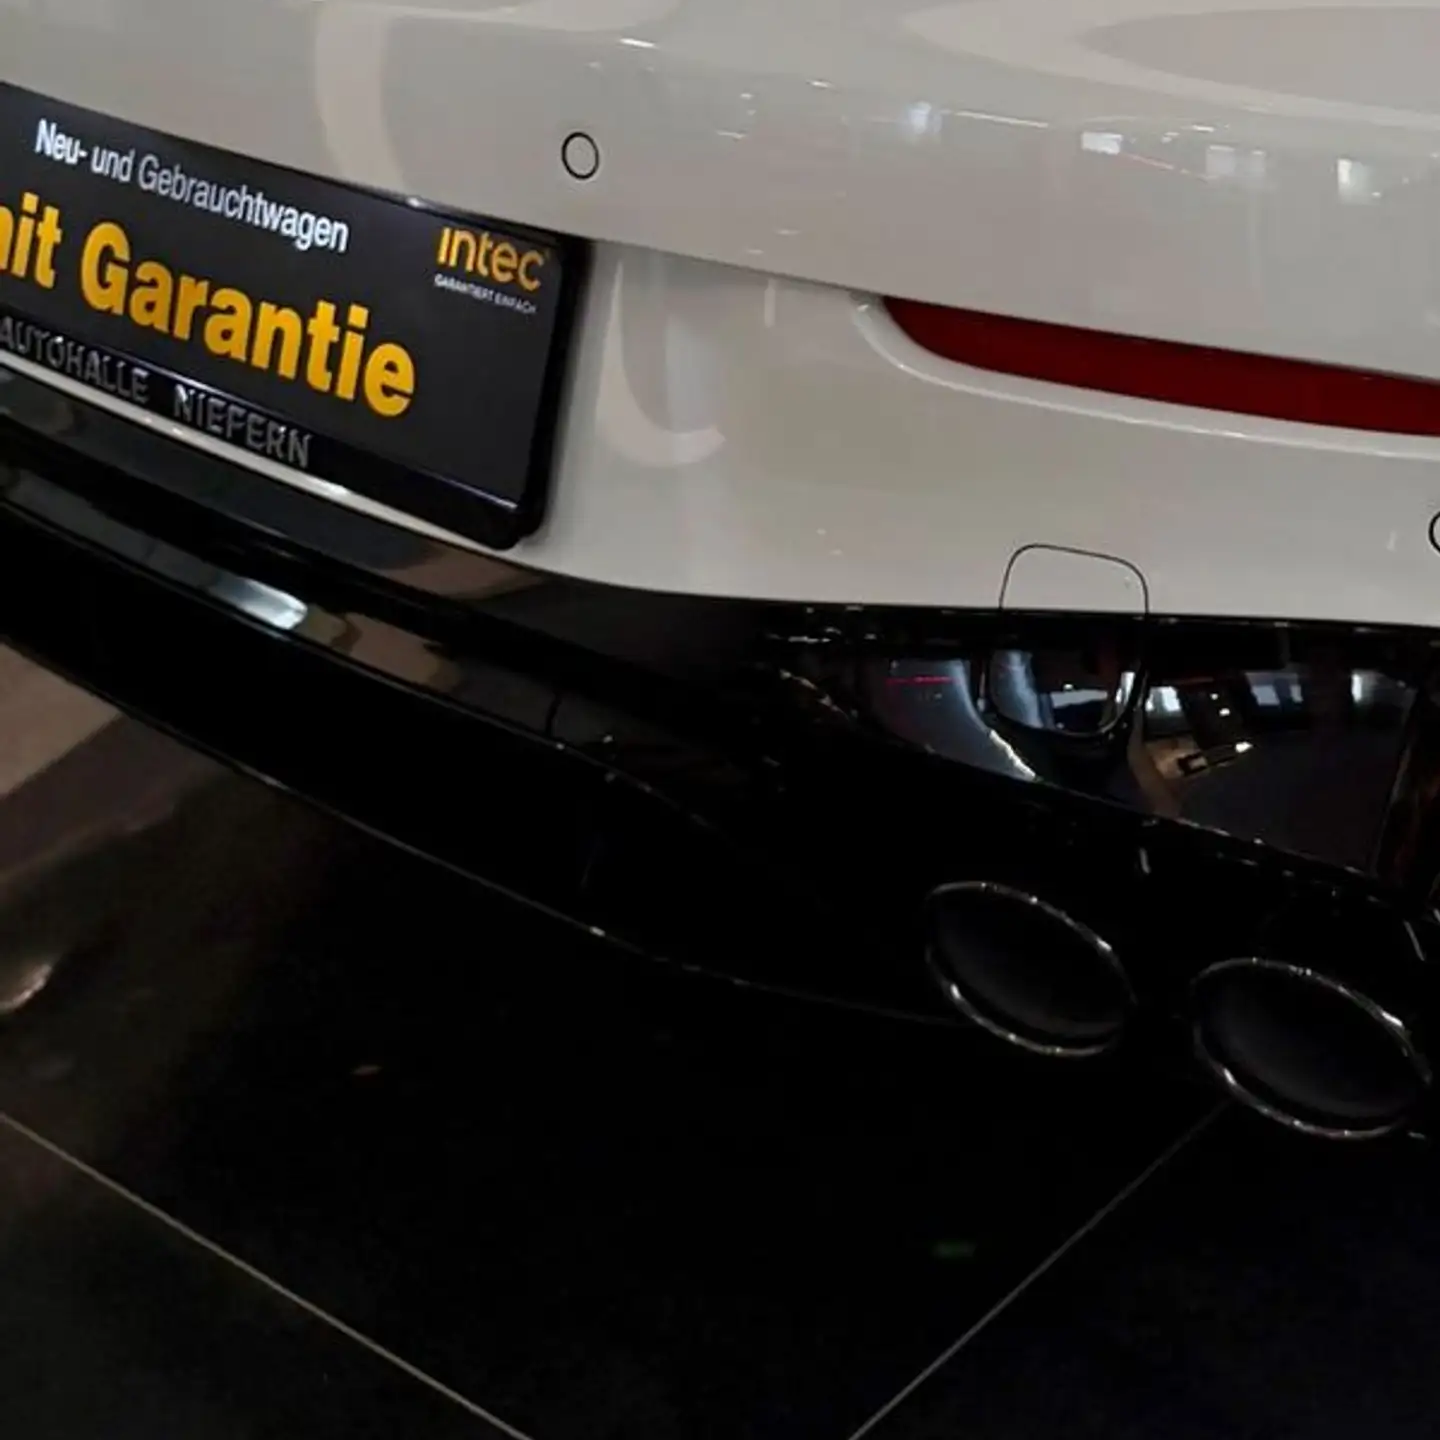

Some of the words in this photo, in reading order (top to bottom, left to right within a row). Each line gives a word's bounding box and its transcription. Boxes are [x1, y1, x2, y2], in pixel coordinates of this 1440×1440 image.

[34, 117, 87, 164] Neu-
[91, 145, 134, 183] und
[138, 154, 349, 253] Gebrauchtwagen
[0, 315, 150, 404] AUTOHALLE
[172, 383, 312, 469] NIEFERN
[80, 221, 416, 418] Garantie
